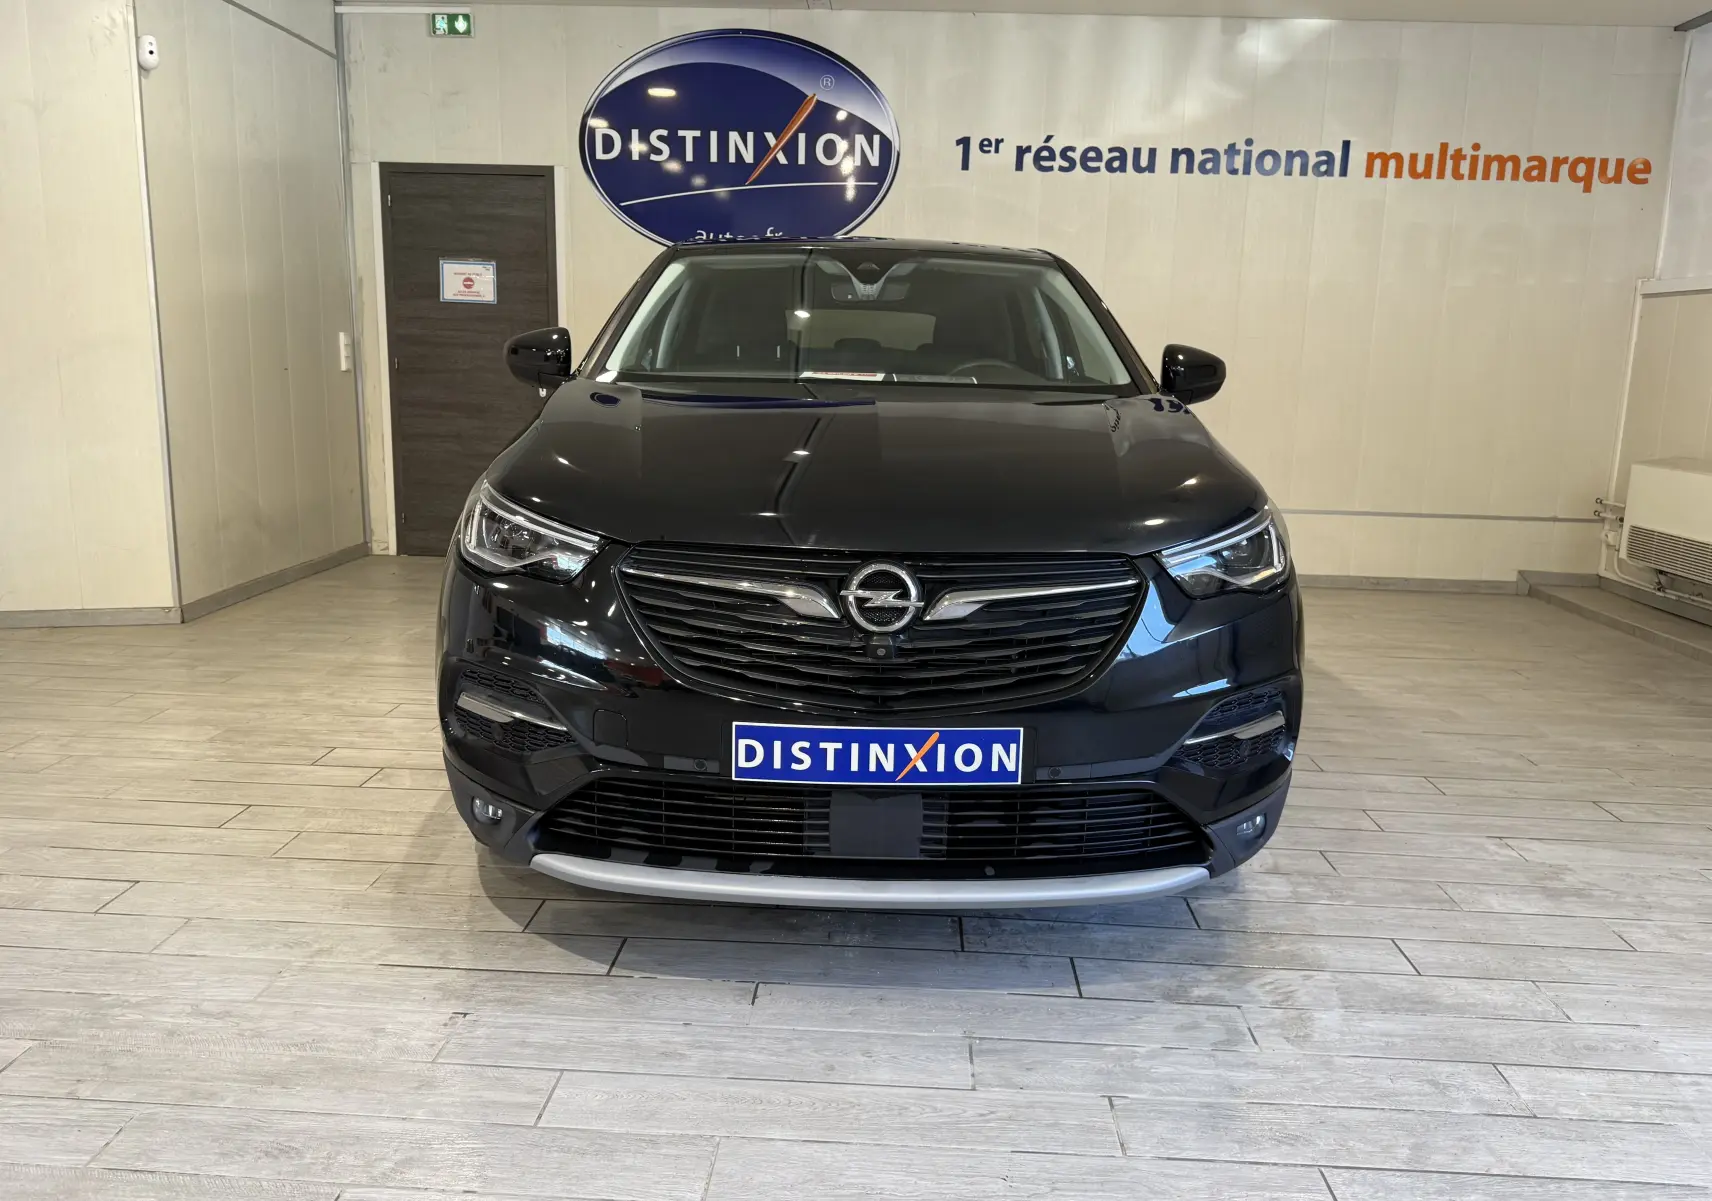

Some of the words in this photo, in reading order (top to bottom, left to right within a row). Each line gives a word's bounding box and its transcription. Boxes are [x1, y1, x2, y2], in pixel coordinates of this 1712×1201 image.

[955, 136, 1004, 171] 1er
[1014, 135, 1157, 174] réseau
[1169, 137, 1351, 177] national
[1364, 142, 1652, 194] multimarque
[737, 731, 1017, 782] DISTINXION
